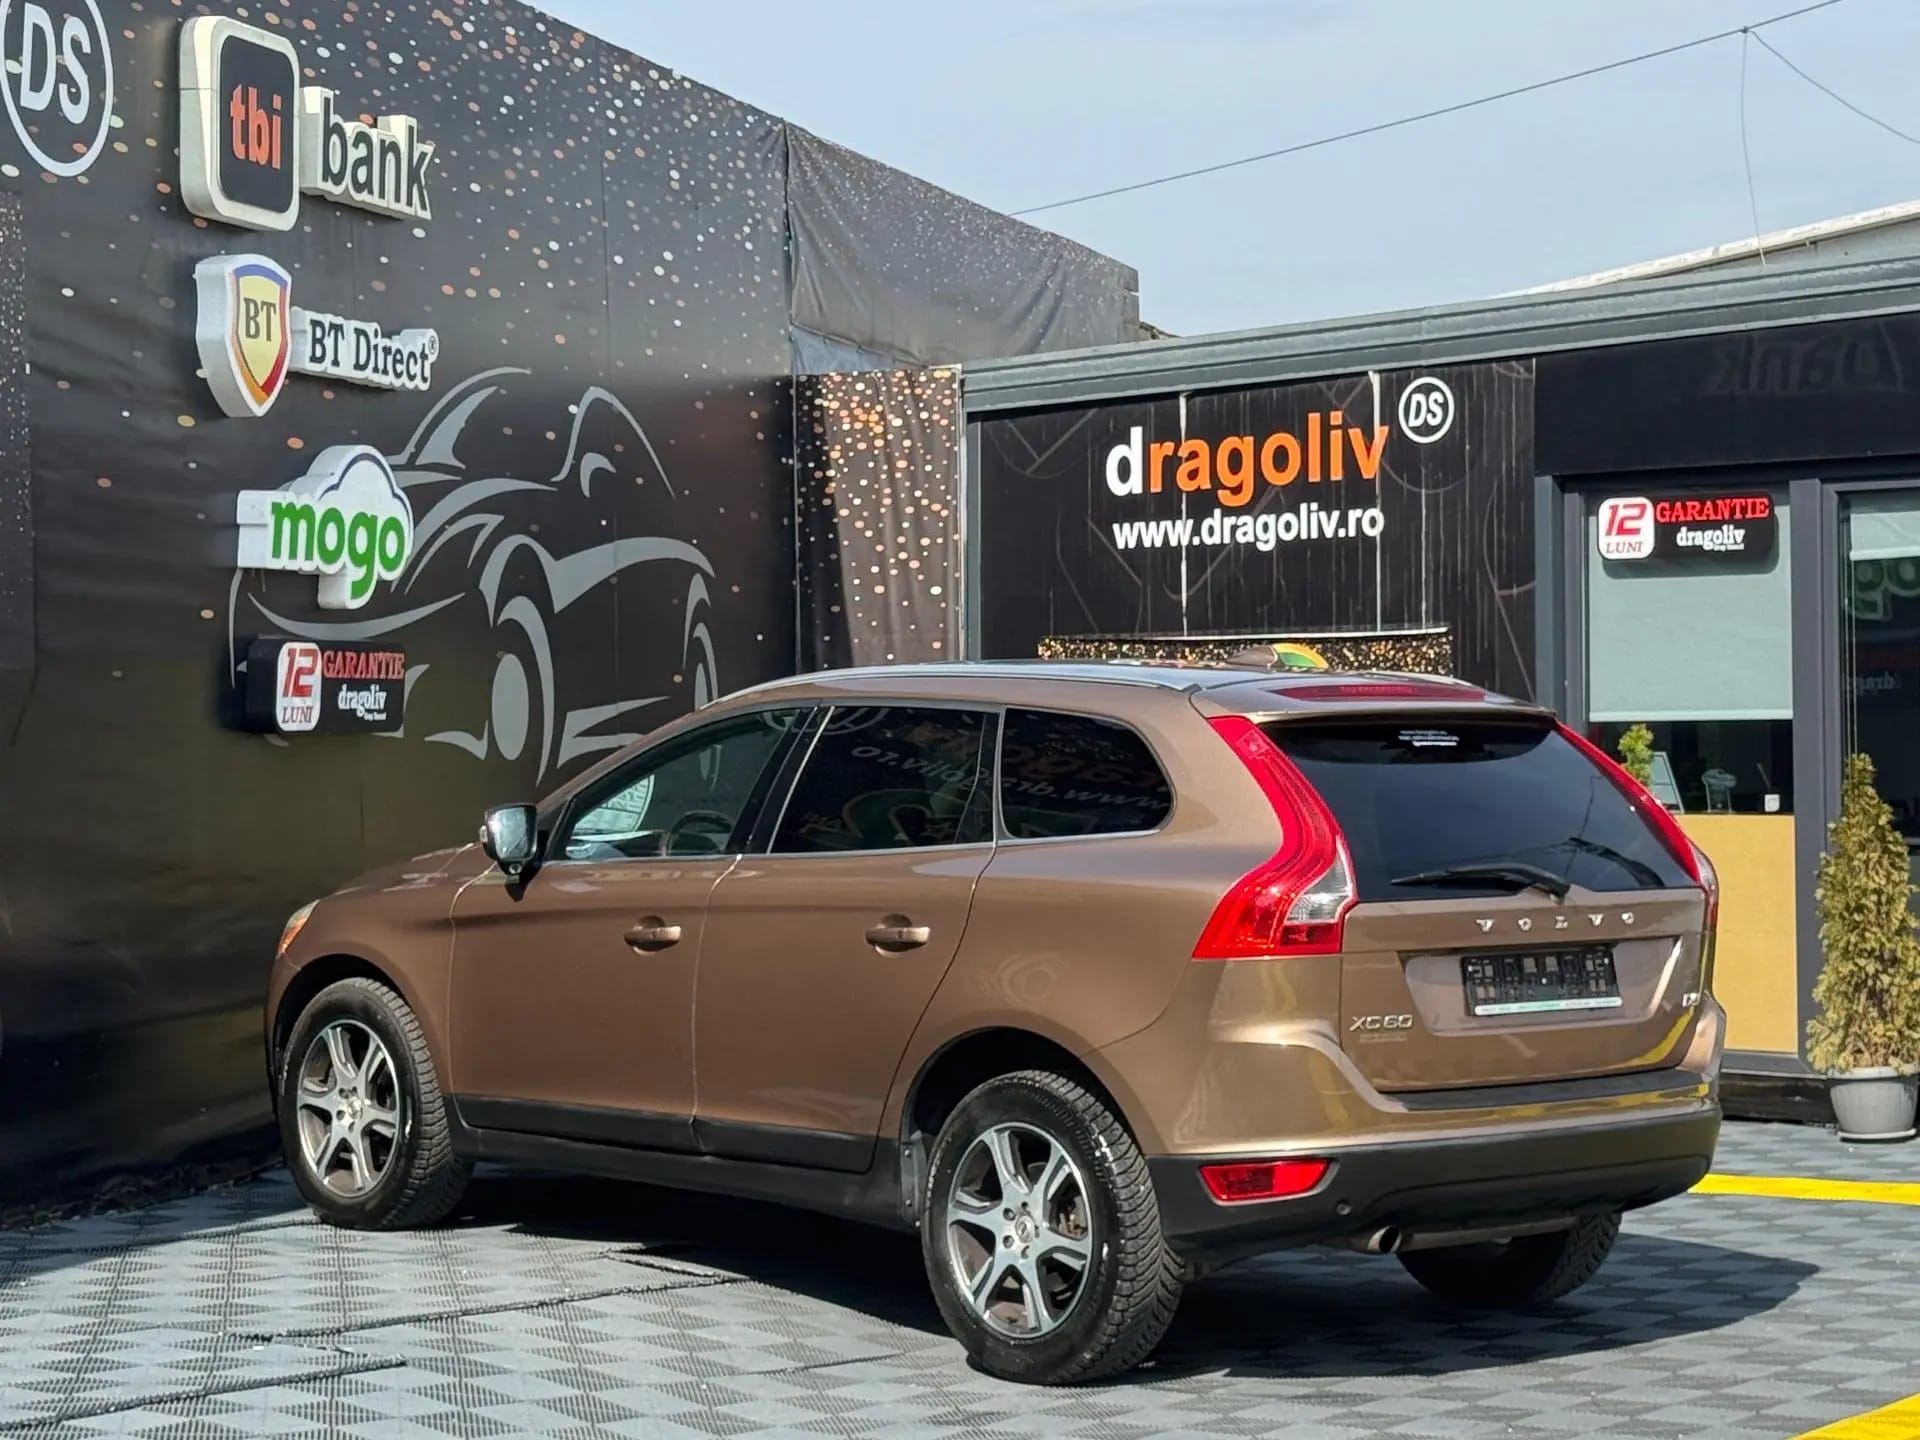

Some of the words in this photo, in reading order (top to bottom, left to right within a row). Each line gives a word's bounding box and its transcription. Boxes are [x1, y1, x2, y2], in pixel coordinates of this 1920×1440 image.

[20, 2, 92, 124] DS
[230, 83, 282, 170] tbi
[322, 97, 429, 216] bank
[243, 297, 277, 342] BT
[309, 319, 344, 368] BT
[1407, 391, 1445, 428] DS
[1105, 410, 1389, 507] dragoliv
[1113, 502, 1385, 552] www.dragoliv.ro
[1605, 503, 1647, 537] 12
[1655, 497, 1770, 524] GARANTIE
[271, 501, 405, 600] mogo
[1606, 542, 1643, 555] LUNI
[1676, 524, 1746, 551] dragoliv
[282, 648, 318, 698] 12
[322, 650, 405, 680] GARANTIE
[282, 705, 313, 724] LUNI
[338, 684, 386, 717] dragoliv
[1349, 1014, 1414, 1032] XC60
